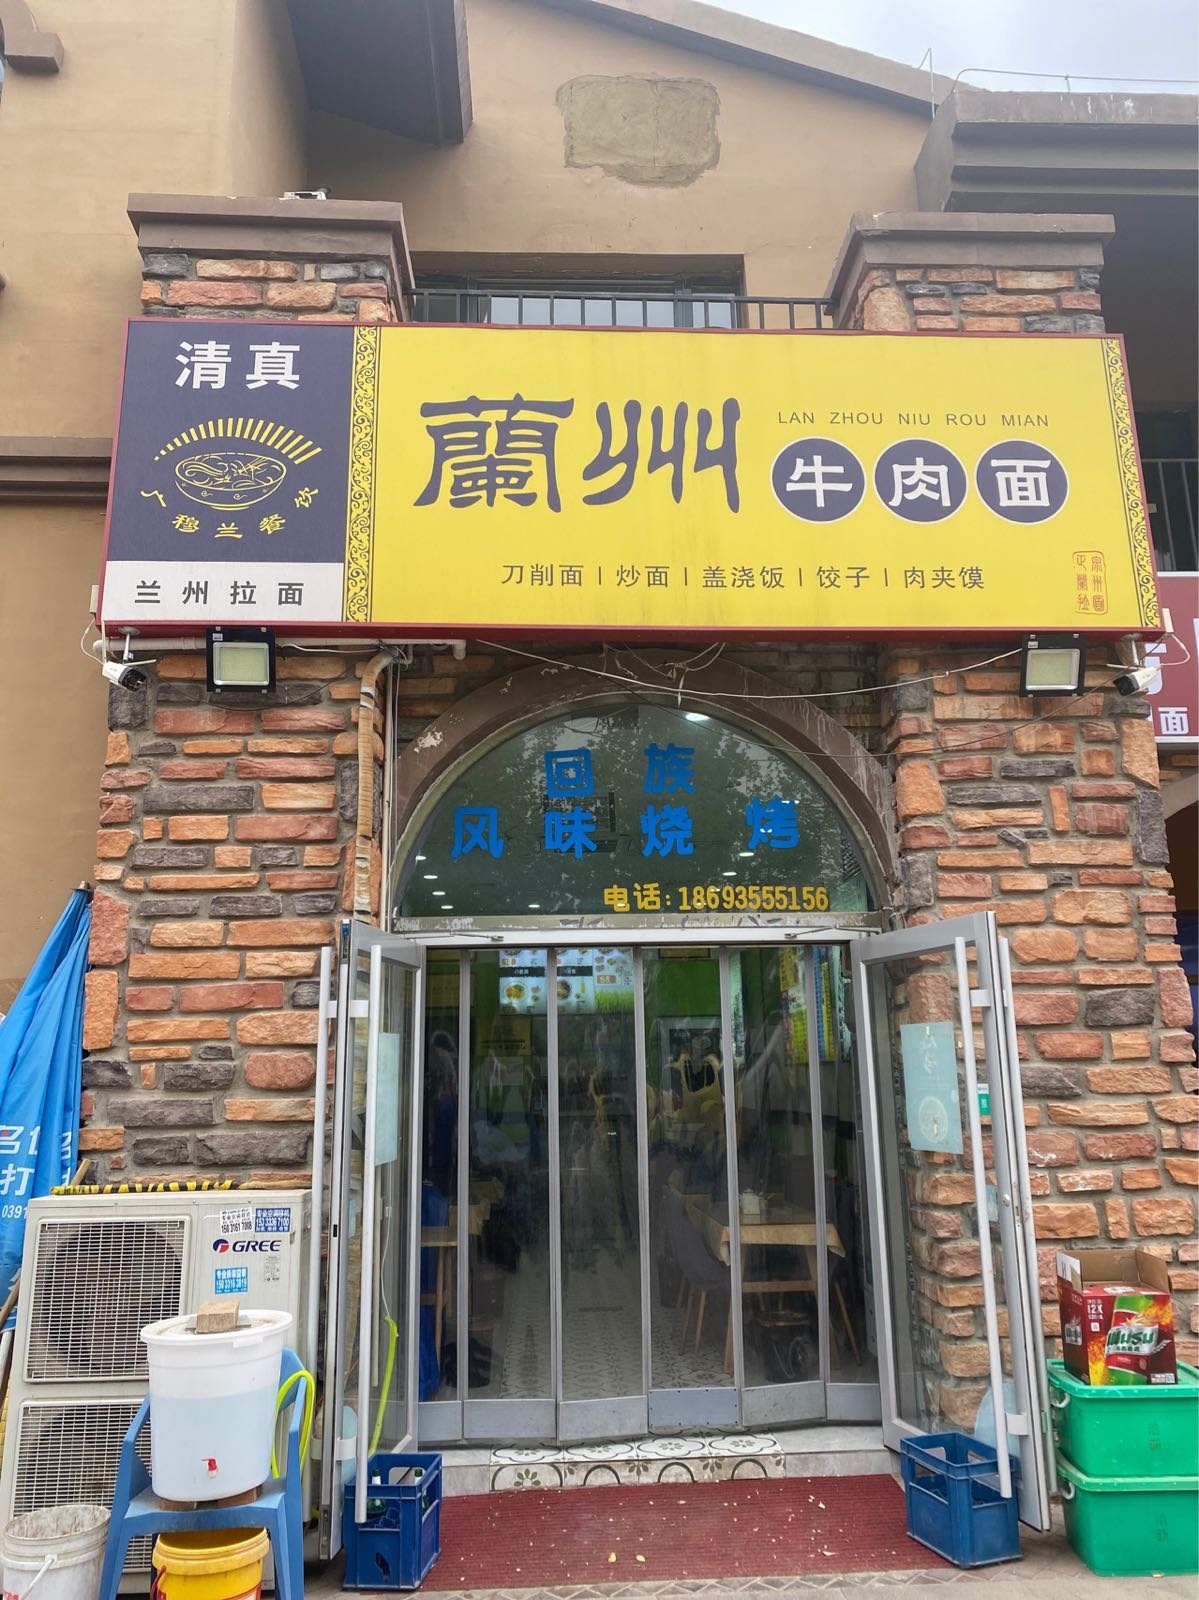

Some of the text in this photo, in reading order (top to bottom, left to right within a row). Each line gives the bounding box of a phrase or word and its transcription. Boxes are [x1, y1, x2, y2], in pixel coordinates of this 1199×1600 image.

[175, 340, 300, 389] 清真
[778, 411, 1049, 427] LAN ZHOU NIU ROU MIAN
[785, 455, 1052, 508] 牛肉面
[501, 564, 985, 590] 刀削面 炒面 盖浇饭 饺子 肉夹馍
[134, 580, 304, 606] 兰州拉面
[1158, 707, 1189, 735] 面
[544, 743, 696, 799] 回族
[451, 796, 801, 860] 风味烧烤
[0, 1163, 35, 1196] 打
[232, 1240, 282, 1252] GREE
